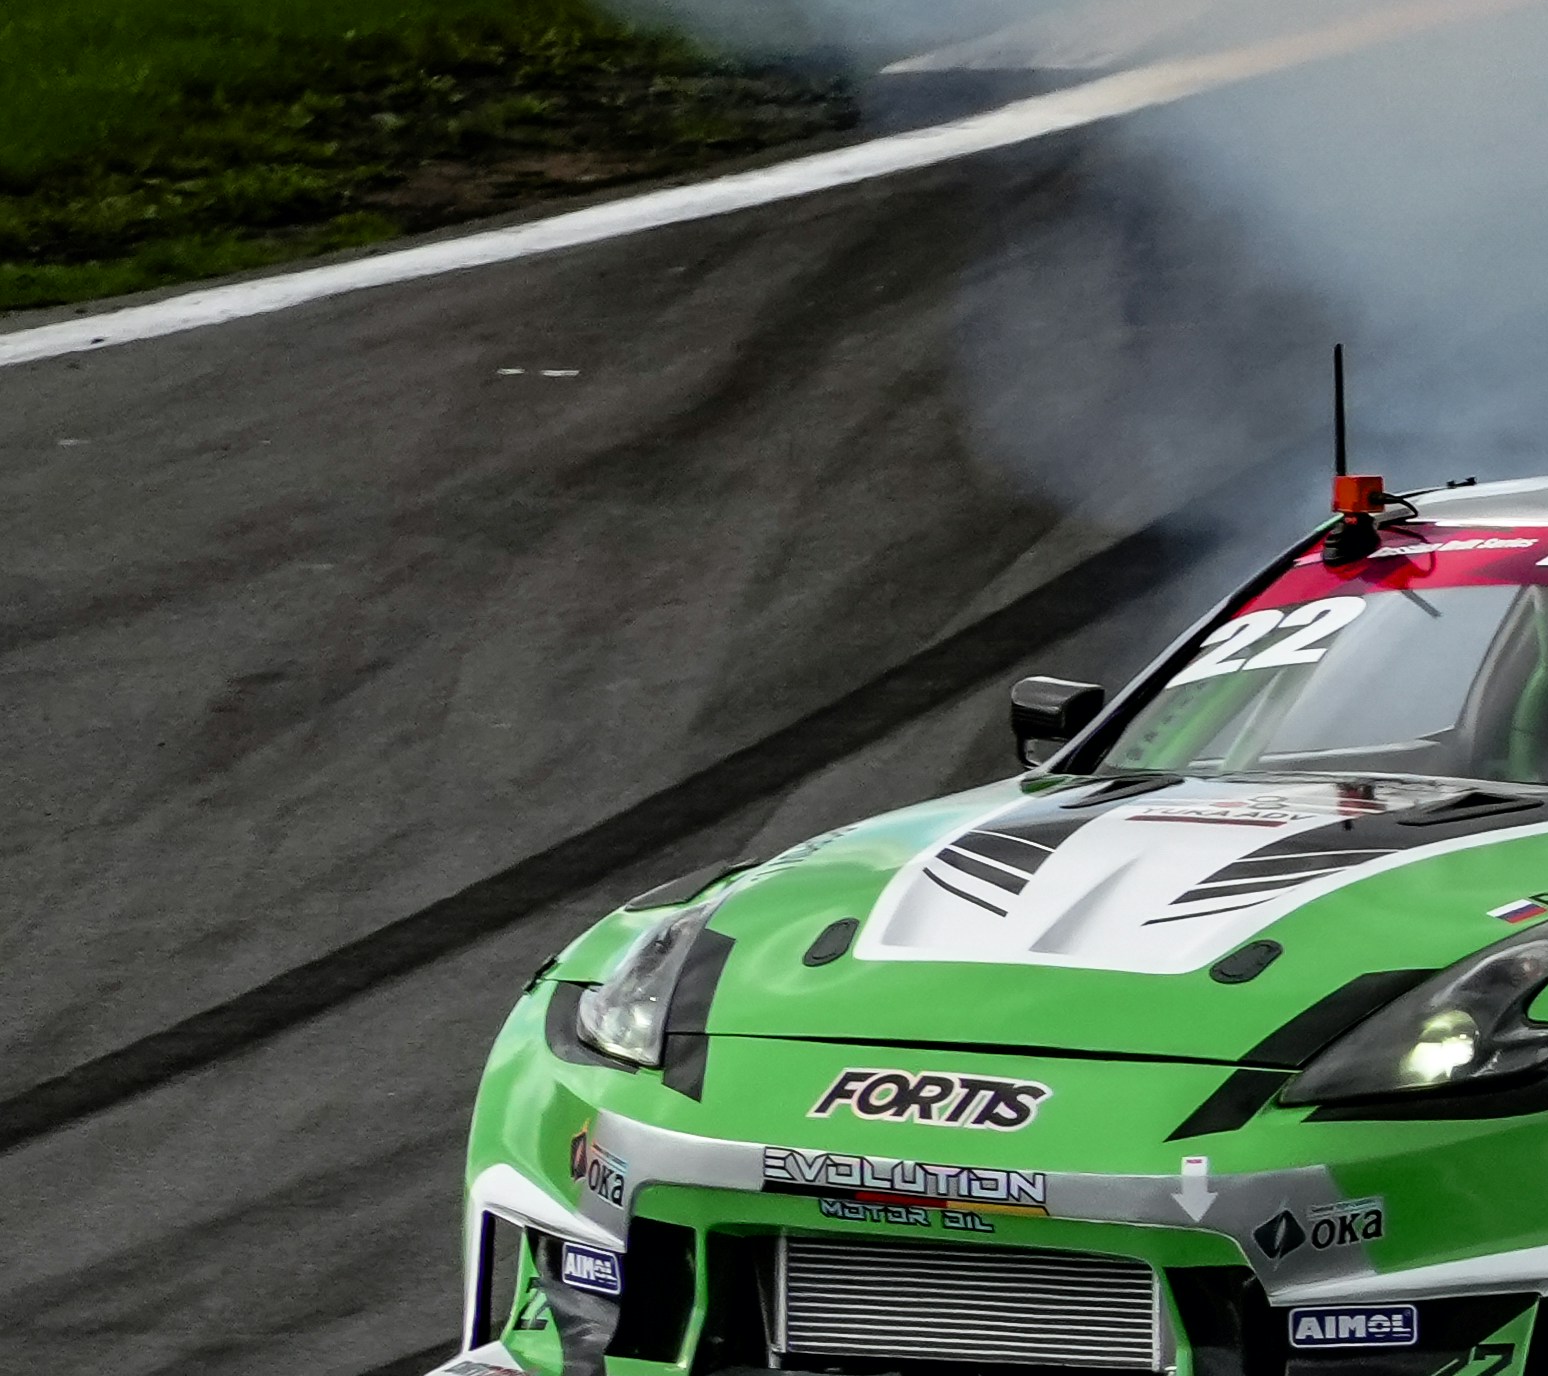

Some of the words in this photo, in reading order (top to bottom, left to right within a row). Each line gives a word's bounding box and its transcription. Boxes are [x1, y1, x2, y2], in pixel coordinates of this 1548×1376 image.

[1166, 595, 1367, 689] 22
[811, 1069, 1049, 1130] FORTIS
[764, 1146, 1047, 1204] EVOLUTION
[819, 1197, 931, 1226] MOTOR
[944, 1210, 995, 1234] OIL
[564, 1252, 618, 1286] AIMOL
[1293, 1313, 1412, 1344] AIMOL
